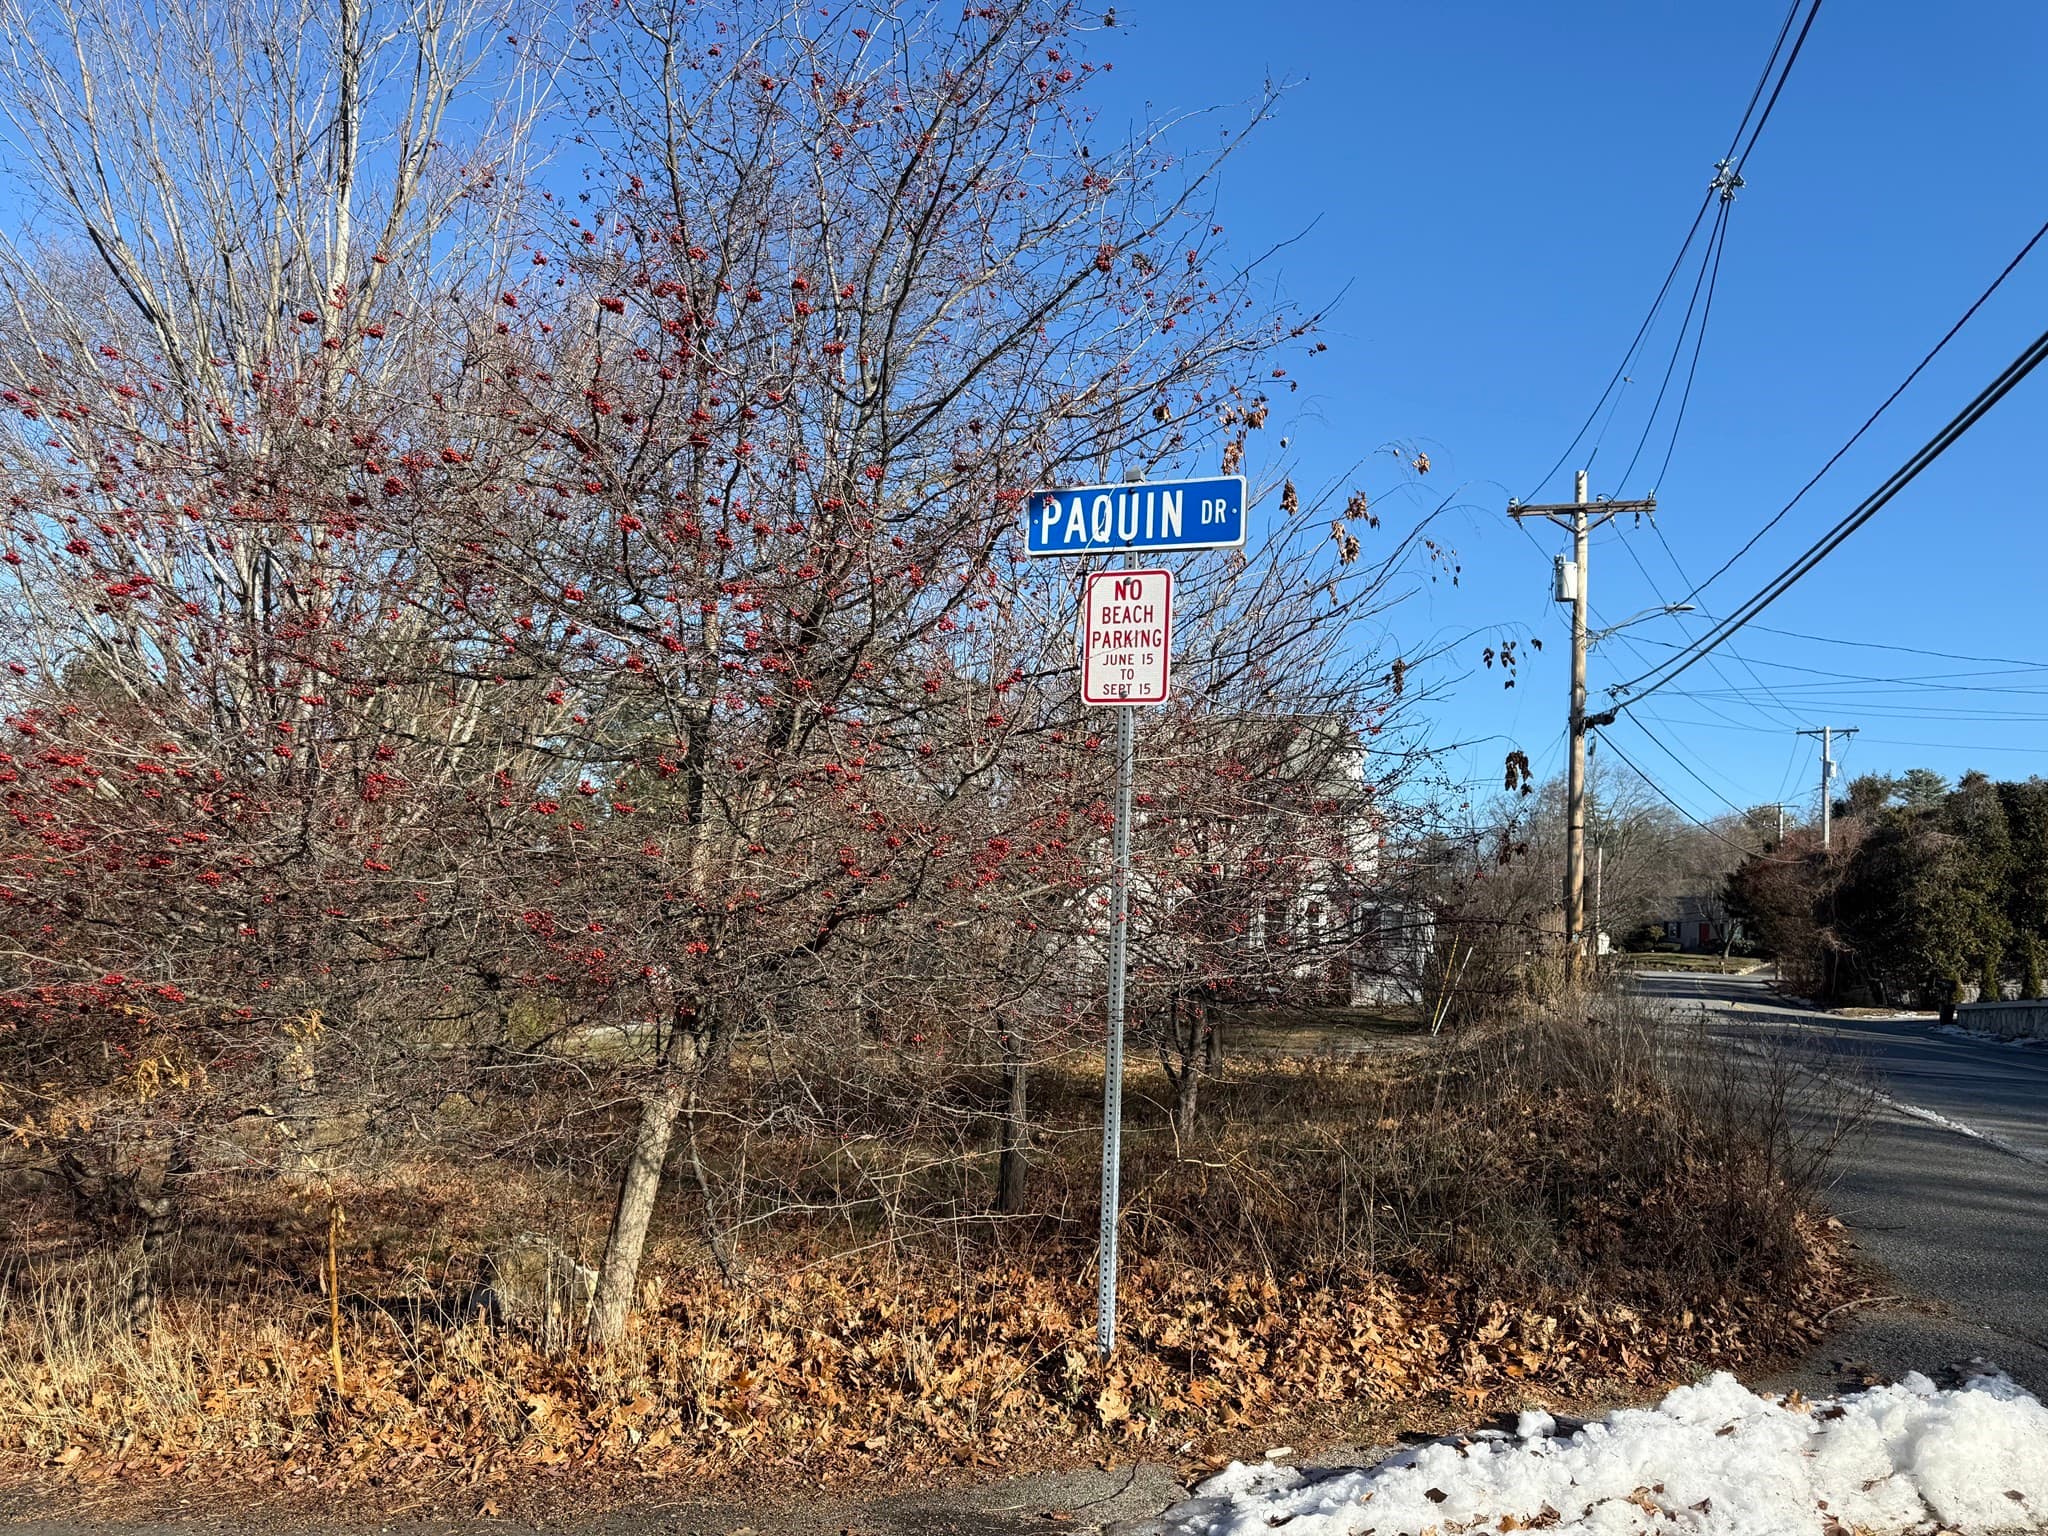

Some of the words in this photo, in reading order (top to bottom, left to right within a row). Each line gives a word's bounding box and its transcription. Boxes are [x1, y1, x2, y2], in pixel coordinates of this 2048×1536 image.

[1041, 490, 1183, 544] PAQUIN
[1201, 499, 1227, 524] DR
[1115, 579, 1142, 601] NO
[1102, 605, 1153, 624] BEACH
[1092, 629, 1162, 648] PARKING
[1102, 654, 1134, 665] JUNE
[1142, 653, 1153, 665] 15
[1120, 668, 1134, 680] TO
[1103, 683, 1132, 695] SEPT
[1139, 683, 1151, 695] 15
